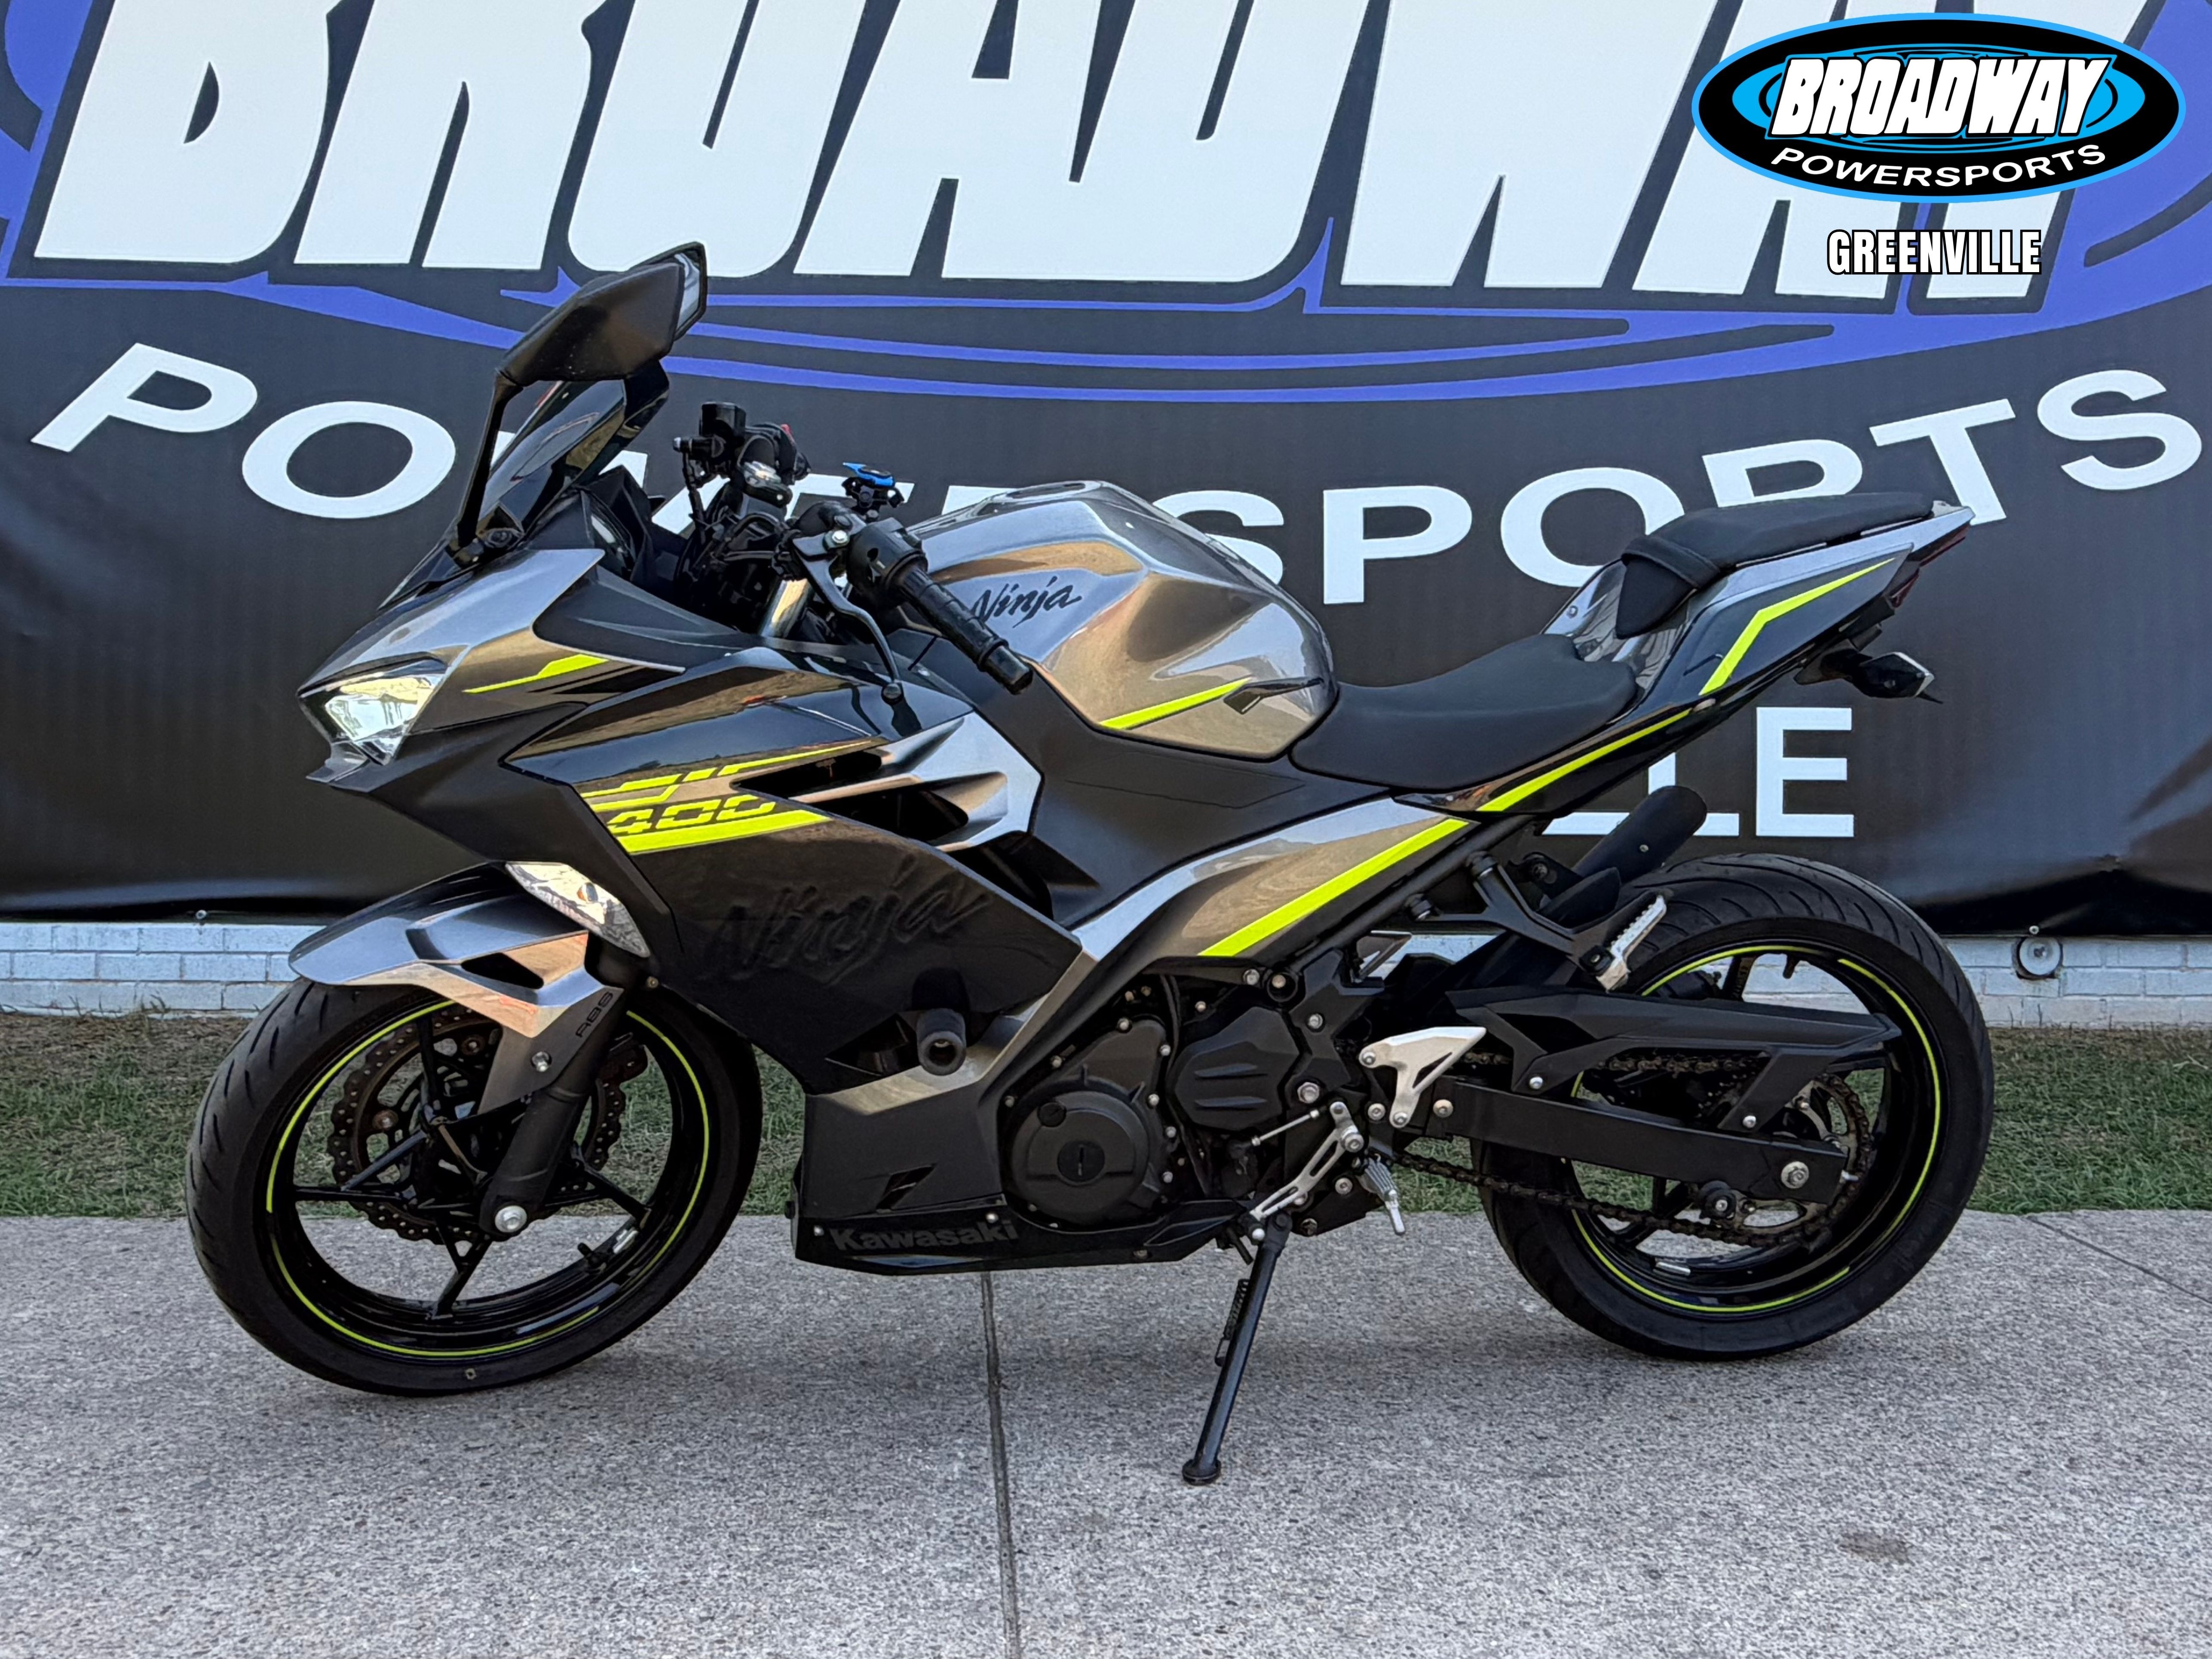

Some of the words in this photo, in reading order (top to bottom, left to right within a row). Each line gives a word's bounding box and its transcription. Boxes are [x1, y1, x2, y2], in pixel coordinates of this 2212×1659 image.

[969, 576, 1082, 628] Ninja
[607, 794, 775, 833] 400
[695, 854, 993, 987] Ninja
[576, 992, 613, 1037] ABS
[829, 1220, 1018, 1250] Kawasaki
